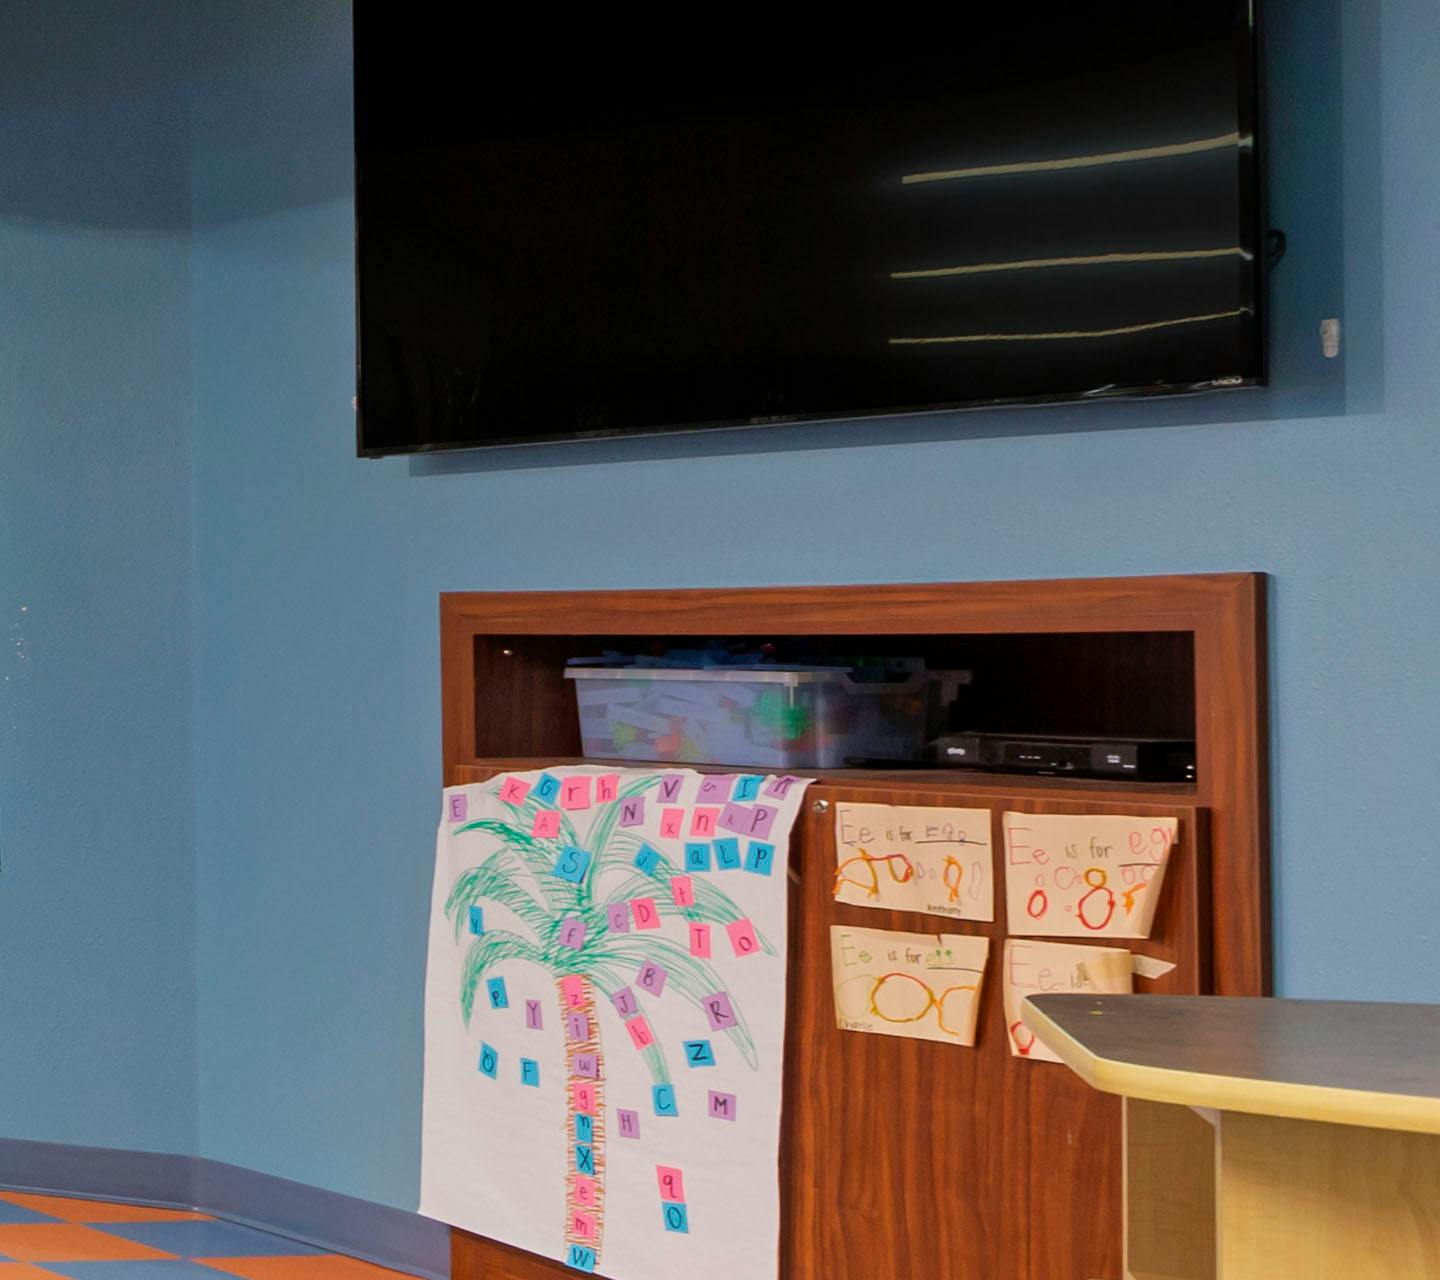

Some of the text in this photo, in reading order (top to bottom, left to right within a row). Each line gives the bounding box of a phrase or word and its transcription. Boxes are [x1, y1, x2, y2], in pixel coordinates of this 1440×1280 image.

[506, 783, 520, 800] K
[568, 786, 581, 802] r
[602, 778, 612, 800] h
[663, 779, 679, 799] V
[452, 799, 463, 818] E
[623, 804, 637, 822] N
[696, 814, 709, 832] n
[720, 844, 733, 864] L
[1007, 827, 1049, 865] Ee
[1064, 844, 1077, 859] is
[1089, 836, 1114, 859] for
[691, 850, 703, 865] a
[637, 904, 650, 924] D
[566, 927, 577, 944] f
[693, 927, 705, 949] T
[905, 947, 923, 964] for
[527, 1002, 538, 1028] Y
[709, 999, 730, 1024] R
[522, 1060, 532, 1081] F
[713, 1095, 728, 1116] M
[620, 1114, 632, 1133] H
[579, 1185, 588, 1201] e
[662, 1173, 678, 1199] q
[575, 1217, 588, 1235] m
